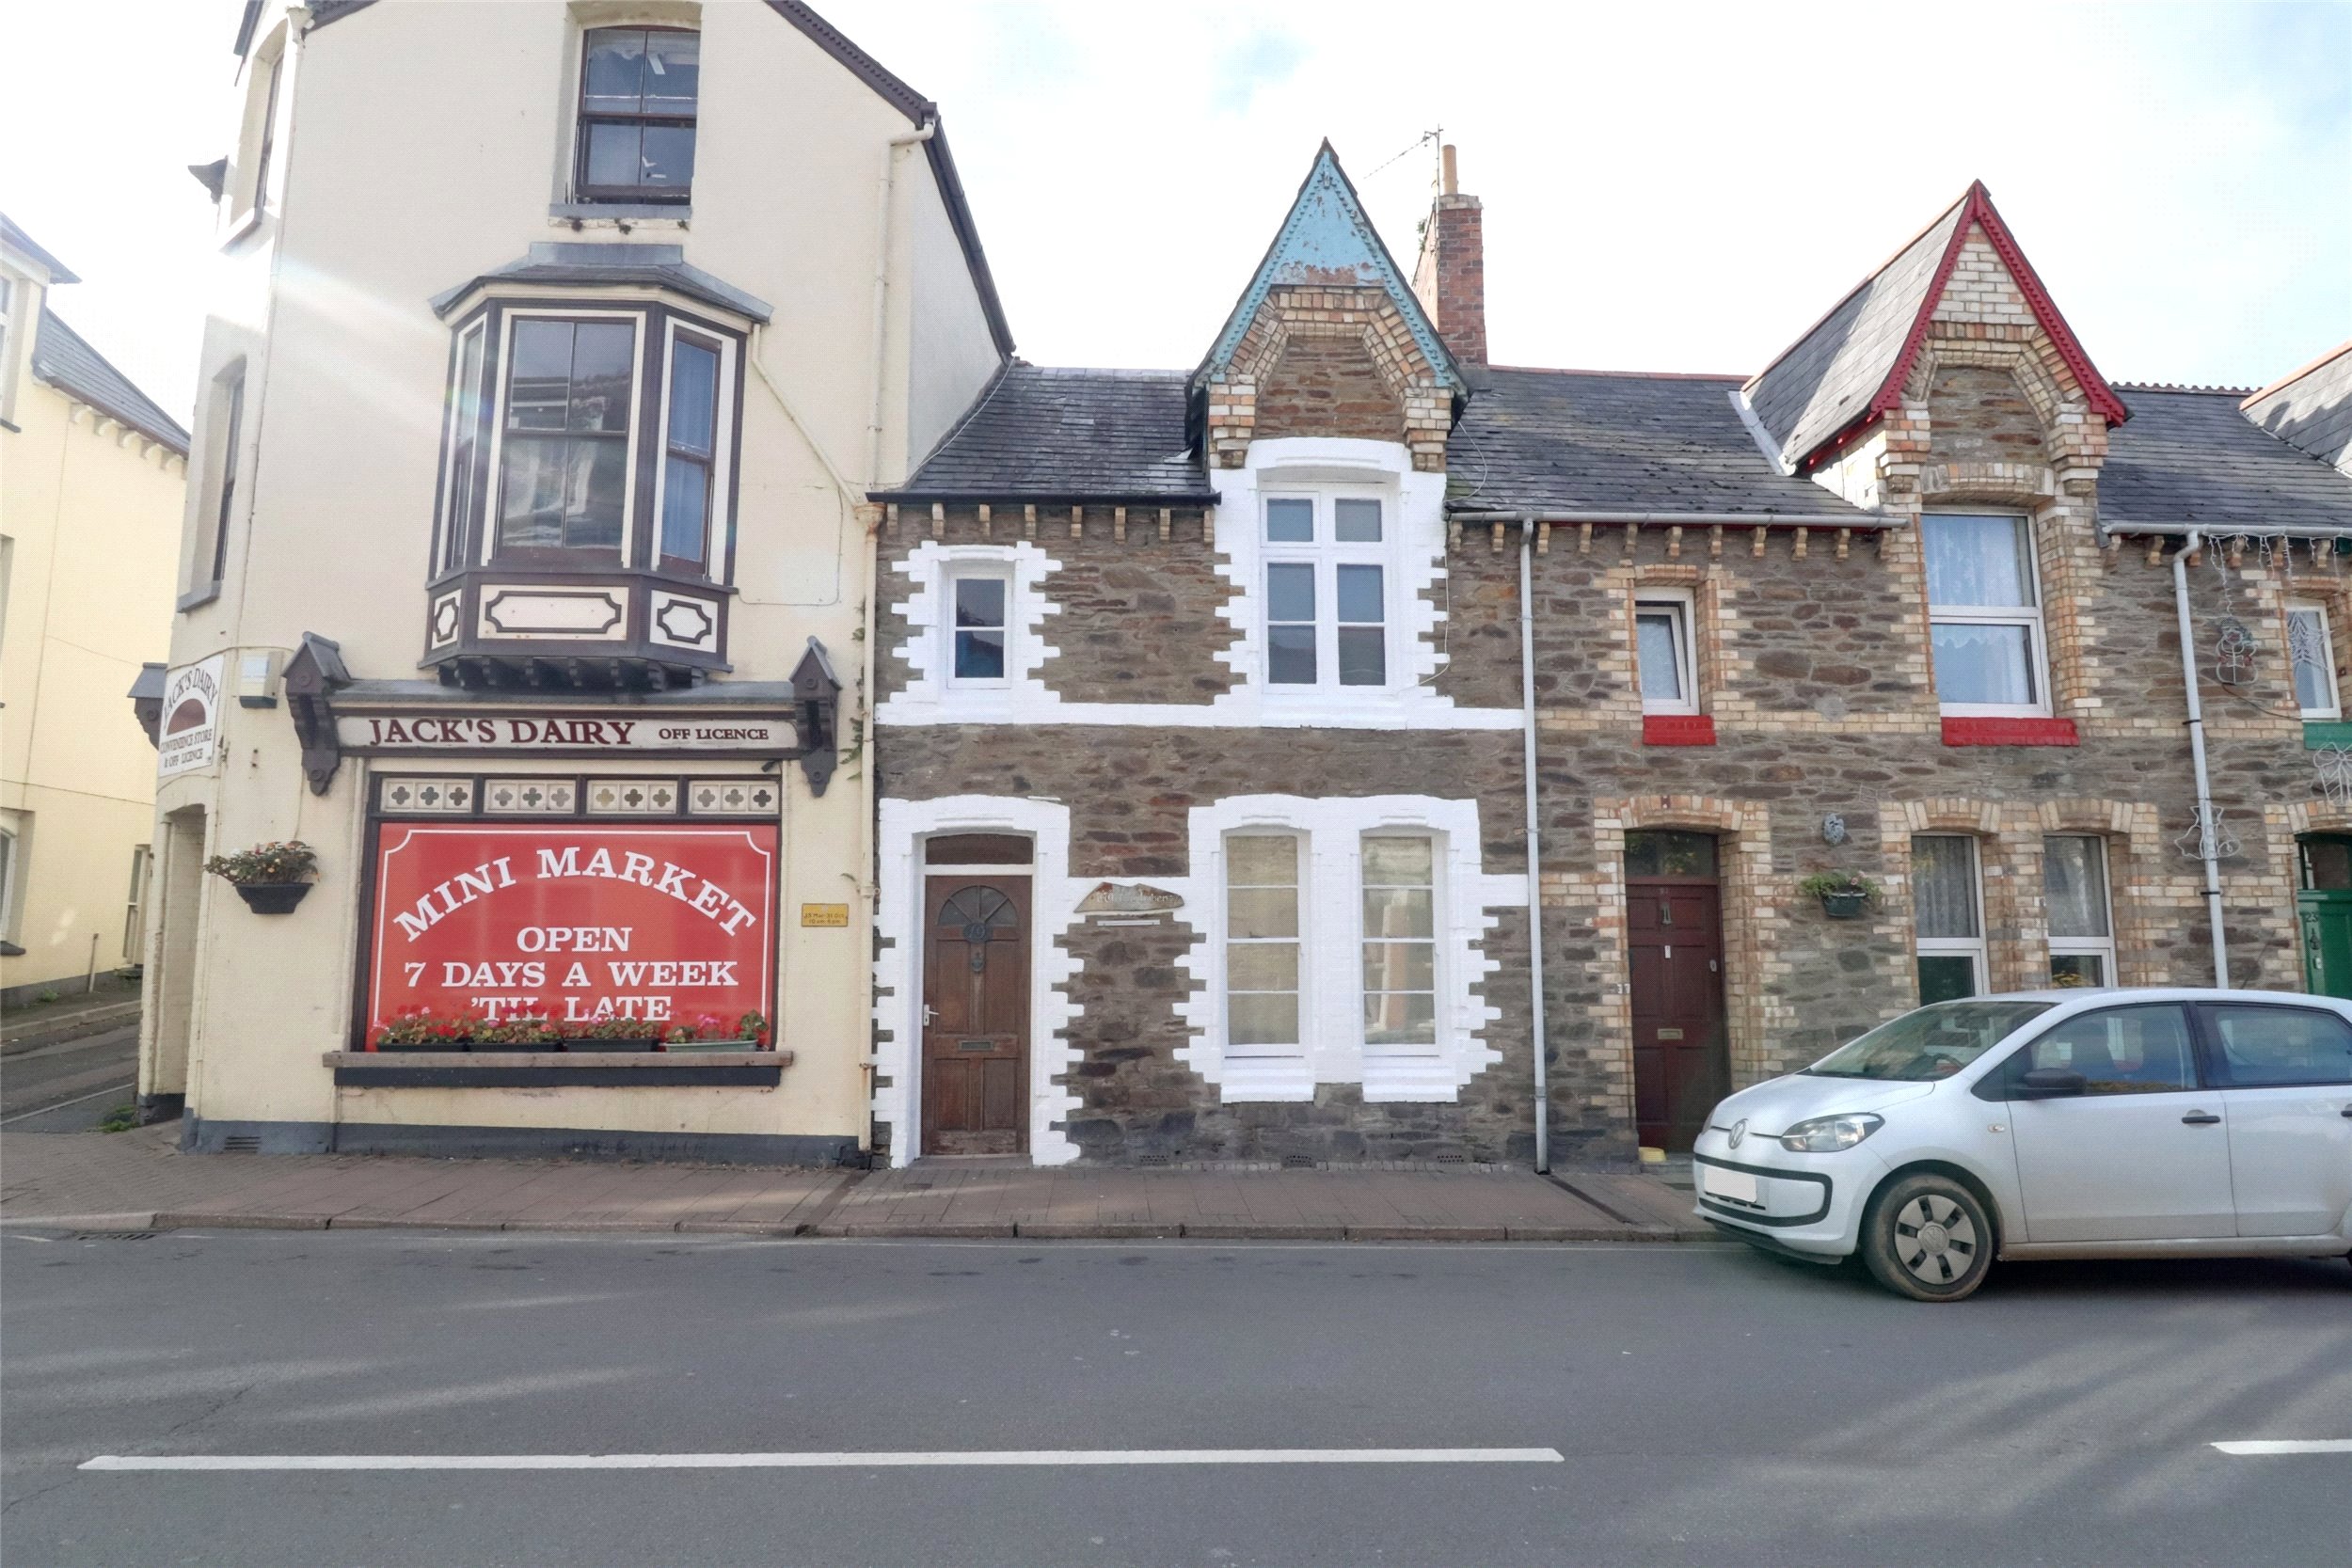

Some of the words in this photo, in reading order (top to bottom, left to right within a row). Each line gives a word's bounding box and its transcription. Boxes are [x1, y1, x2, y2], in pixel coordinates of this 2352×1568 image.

[164, 670, 193, 730] JACK'S
[192, 668, 218, 706] DAIRY
[160, 734, 193, 754] CONVENIENCE
[194, 728, 213, 745] STORE
[369, 719, 497, 746] JACK'S
[508, 719, 636, 745] DAIRY
[659, 728, 691, 739] OFF
[695, 728, 770, 739] LICENCE
[169, 754, 179, 768] OFF
[181, 748, 203, 765] LICENCE
[392, 856, 516, 943] MINI
[536, 847, 756, 938] MARKET
[516, 927, 633, 952] OPEN
[405, 962, 426, 987] 7
[441, 962, 546, 988] DAYS
[562, 962, 592, 987] A
[608, 961, 739, 987] WEEK
[564, 996, 671, 1022] LATE
